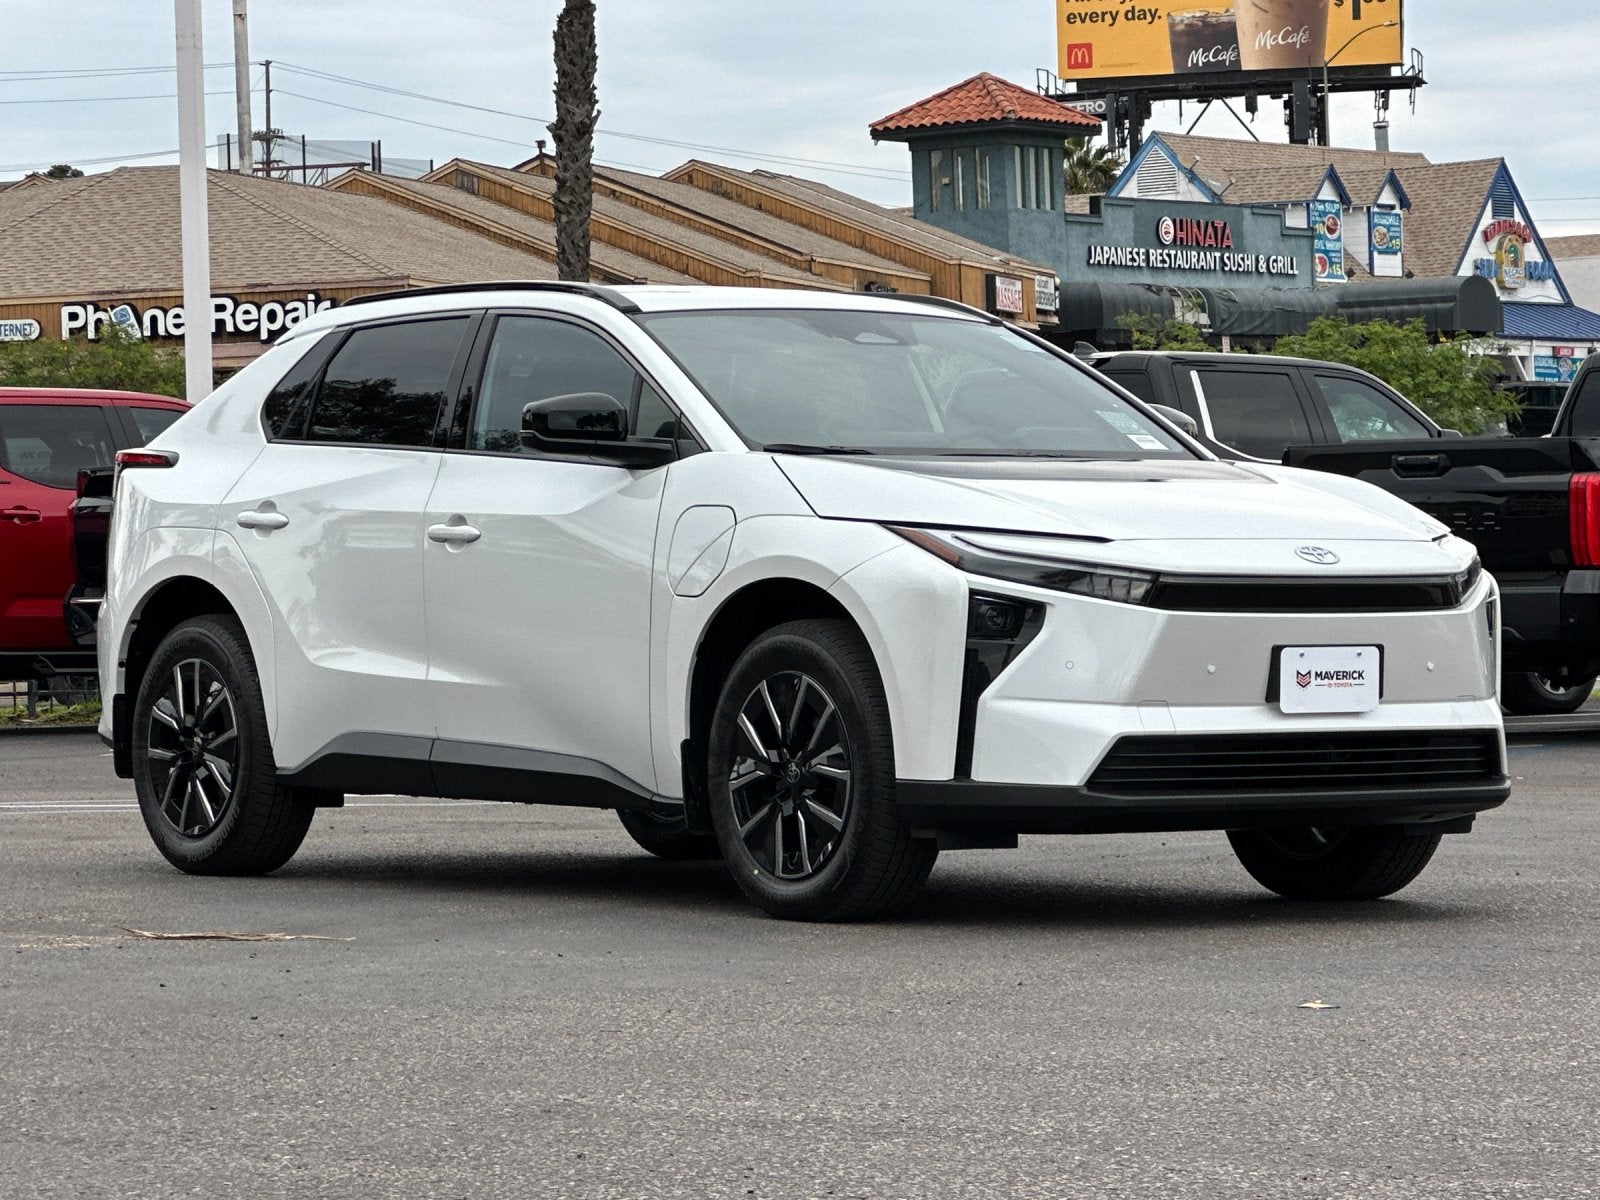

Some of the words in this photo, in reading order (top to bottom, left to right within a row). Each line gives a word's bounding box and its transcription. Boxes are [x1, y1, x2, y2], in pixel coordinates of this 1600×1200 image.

[1066, 9, 1120, 26] every
[1124, 5, 1162, 24] day.
[1254, 25, 1311, 50] McCafé
[1187, 44, 1238, 67] McCafé
[1175, 217, 1234, 248] HINATA
[1089, 245, 1146, 267] JAPANESE
[1149, 248, 1221, 270] RESTAURANT
[1223, 252, 1255, 272] SUSHI
[1258, 254, 1266, 273] &
[1269, 255, 1299, 275] GRILL
[1314, 670, 1365, 681] MAVERICK
